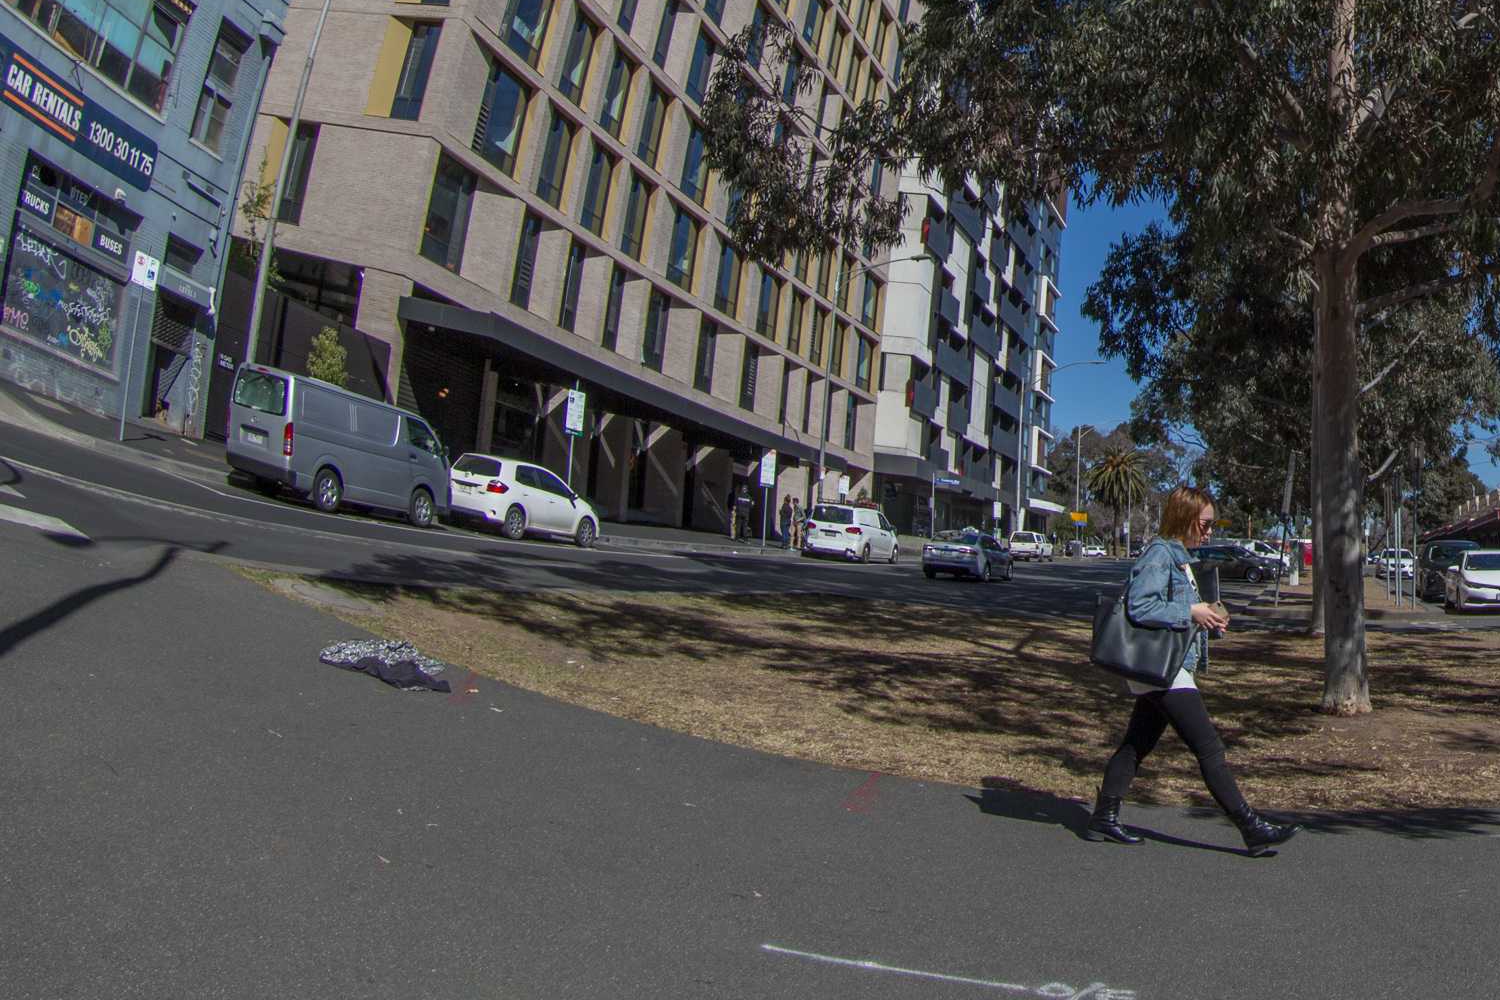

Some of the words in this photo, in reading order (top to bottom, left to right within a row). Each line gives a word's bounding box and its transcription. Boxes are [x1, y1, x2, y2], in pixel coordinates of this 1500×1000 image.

[7, 64, 32, 98] CAR
[32, 81, 82, 131] RENTALS
[88, 120, 114, 152] 1300
[100, 234, 123, 255] BUSES
